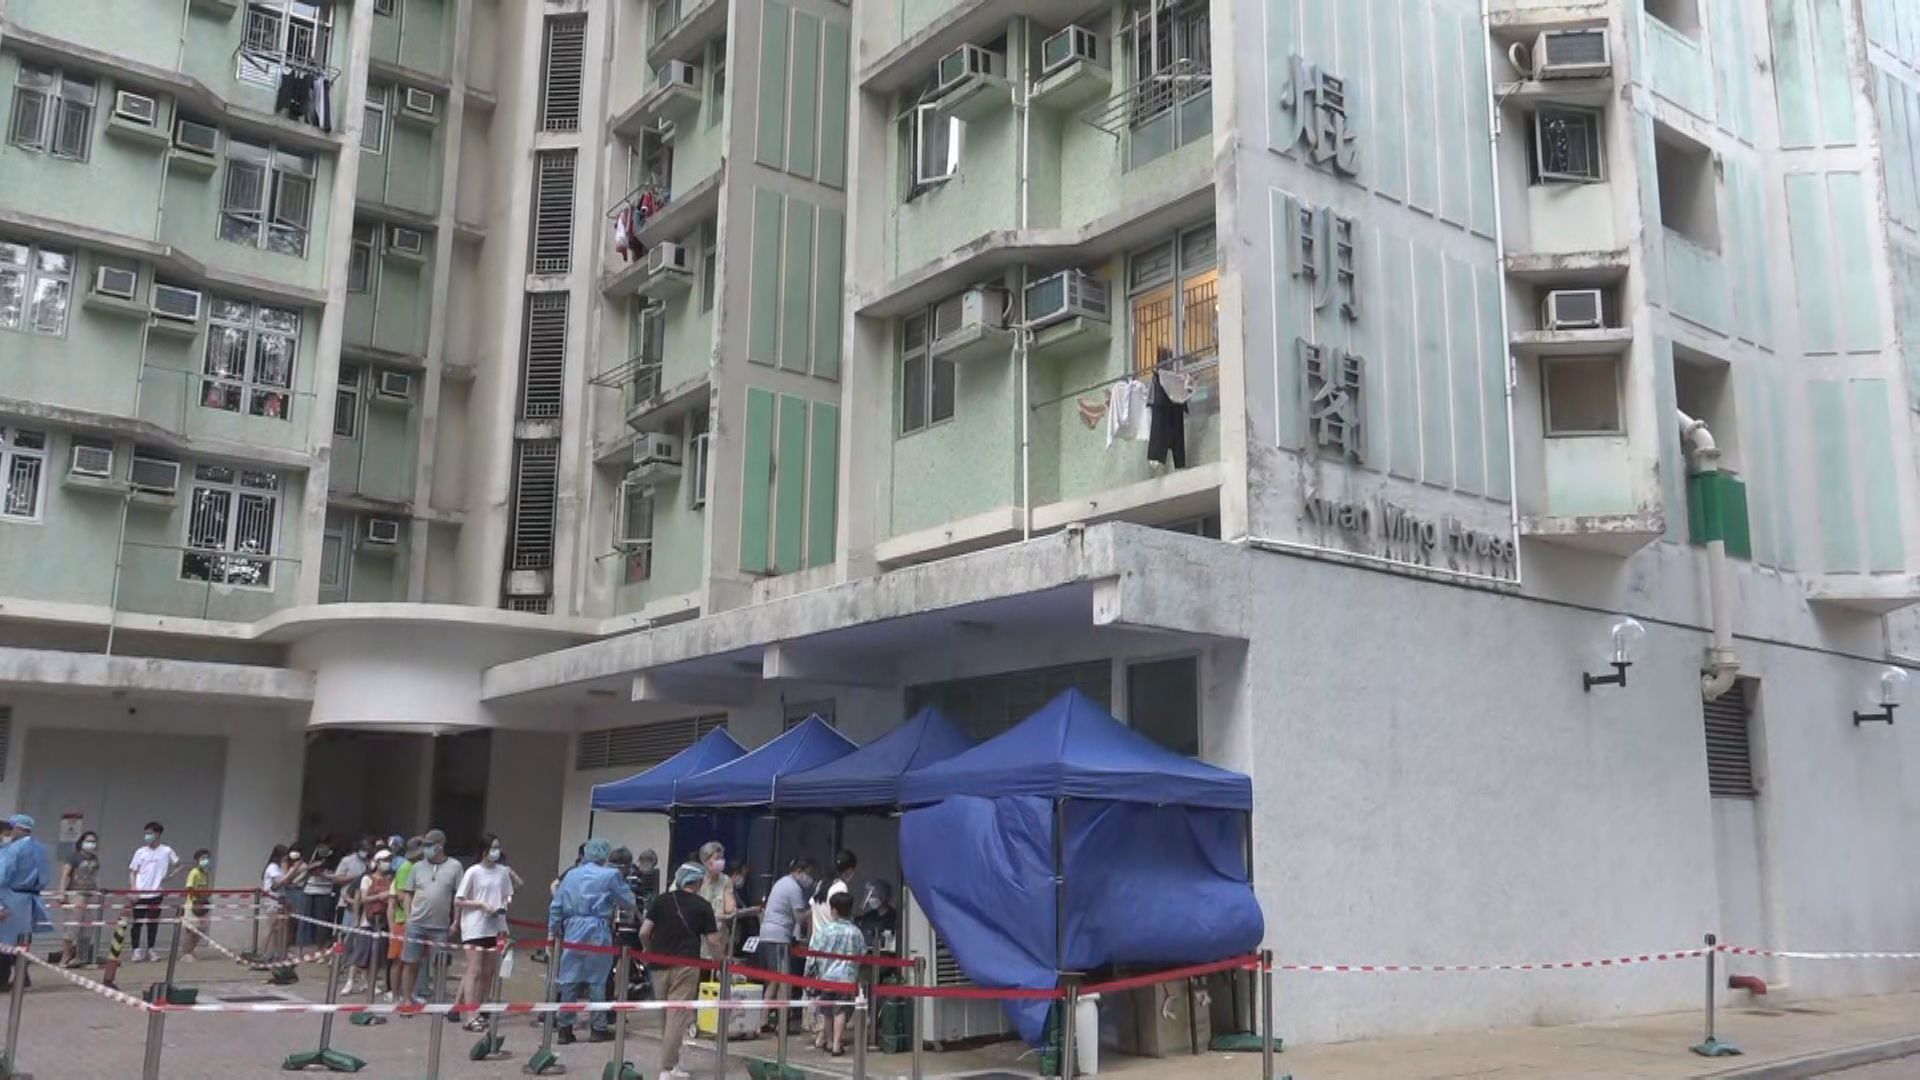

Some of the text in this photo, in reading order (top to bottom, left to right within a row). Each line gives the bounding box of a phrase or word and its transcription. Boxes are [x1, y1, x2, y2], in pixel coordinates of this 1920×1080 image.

[1280, 53, 1367, 466] 焜明閣
[1299, 486, 1515, 562] Kwan Ming House
